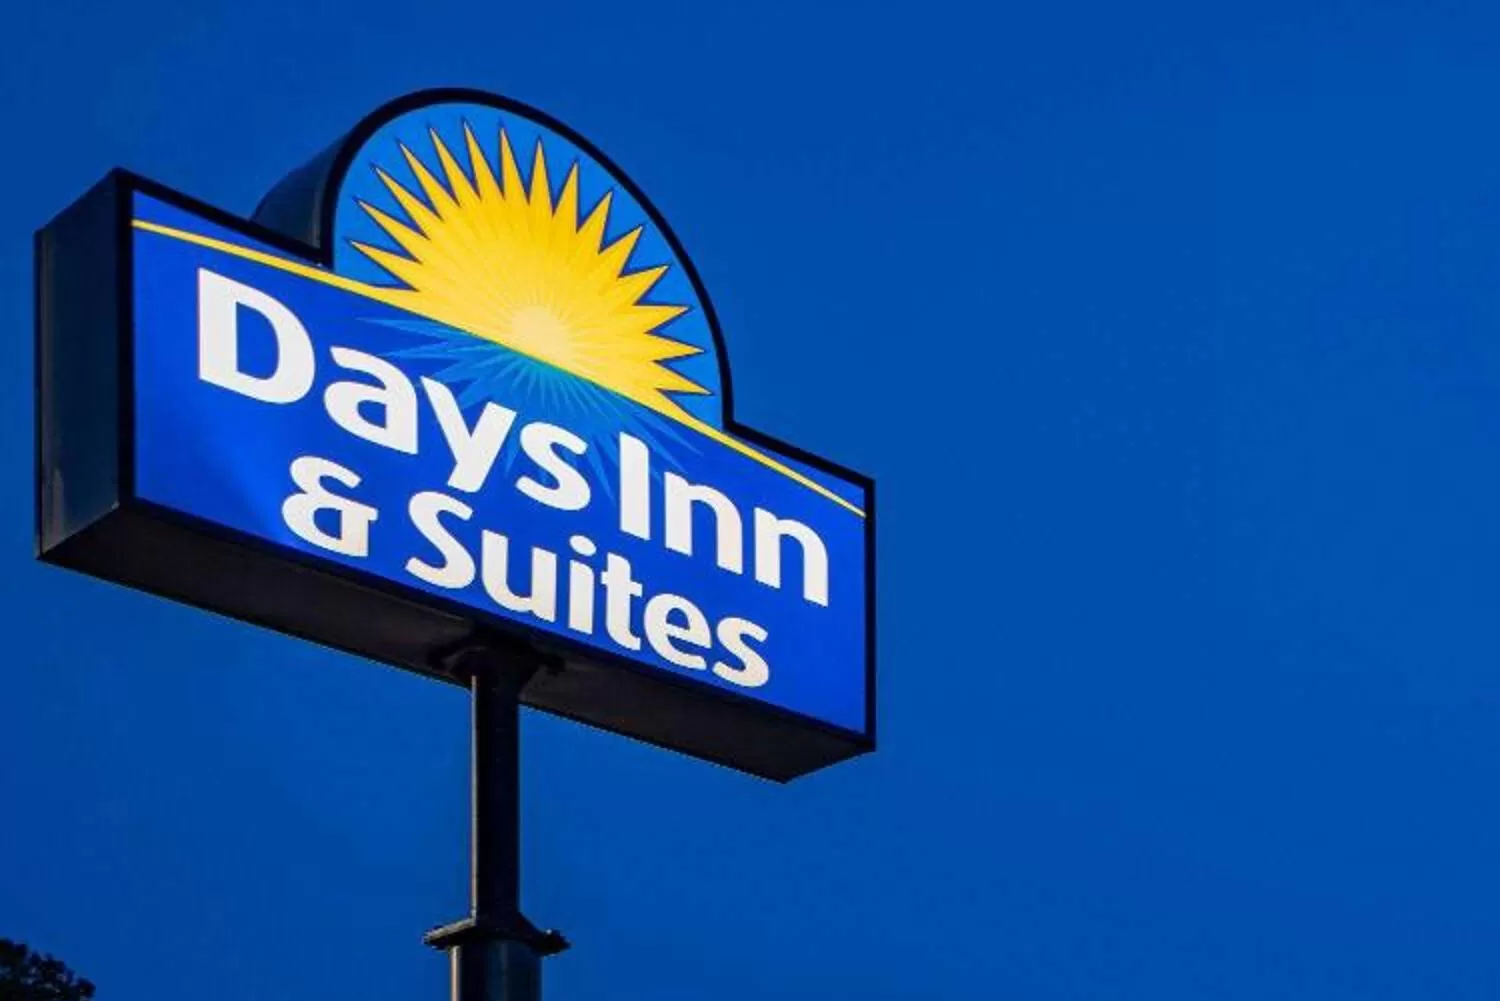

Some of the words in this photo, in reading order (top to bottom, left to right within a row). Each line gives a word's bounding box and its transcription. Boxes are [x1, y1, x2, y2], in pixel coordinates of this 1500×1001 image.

[197, 267, 592, 511] Days
[619, 432, 829, 607] Inn
[281, 455, 378, 558] &
[405, 490, 770, 688] Suites
